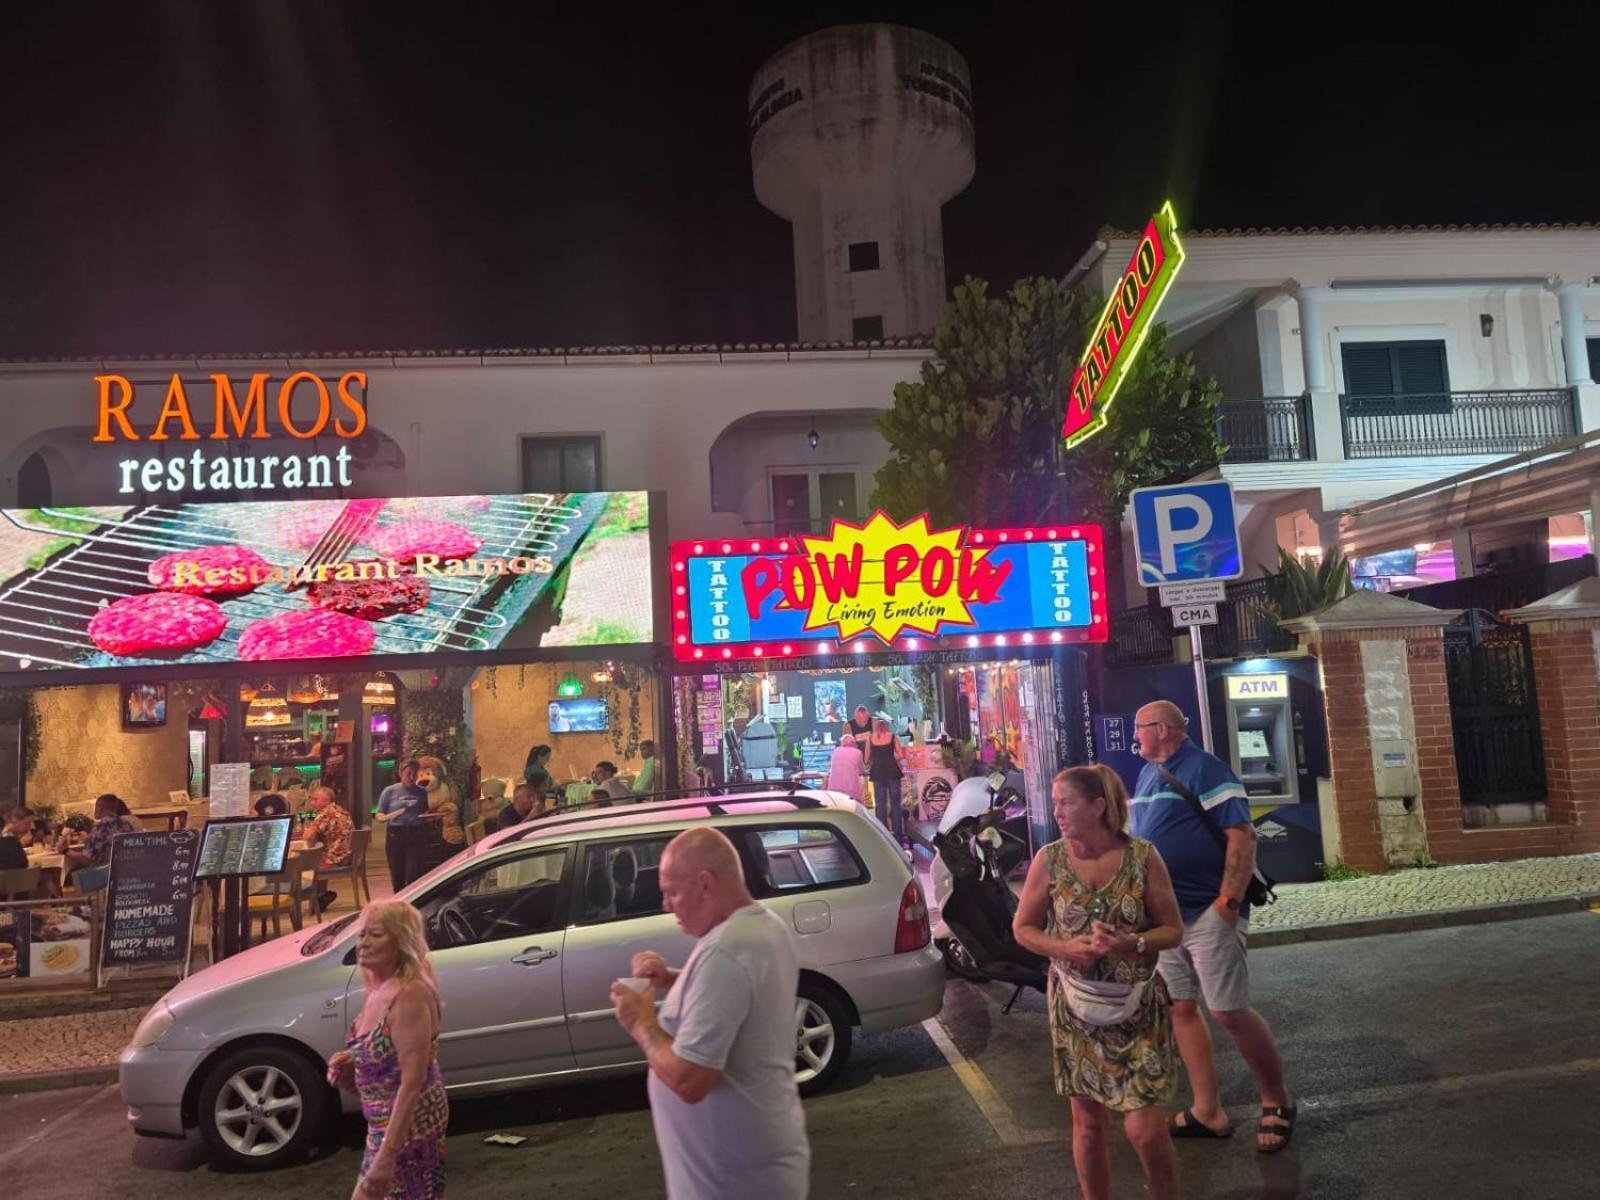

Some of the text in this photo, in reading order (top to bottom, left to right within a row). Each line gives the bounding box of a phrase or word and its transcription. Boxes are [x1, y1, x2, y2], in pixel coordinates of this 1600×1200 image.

[1073, 237, 1156, 415] TATTOO
[93, 370, 368, 443] RAMOS
[118, 445, 354, 495] restaurant
[1153, 493, 1214, 575] P
[174, 552, 554, 589] Restaurant Ramos
[741, 542, 1014, 620] POW POW
[1048, 543, 1073, 622] TATTOO
[707, 560, 731, 640] TATTOO
[826, 599, 946, 626] Living Emotion
[1180, 608, 1212, 621] CMA
[1239, 680, 1278, 693] ATM
[114, 904, 175, 920] HOMEMADE
[110, 935, 175, 950] HAPPY HOUR
